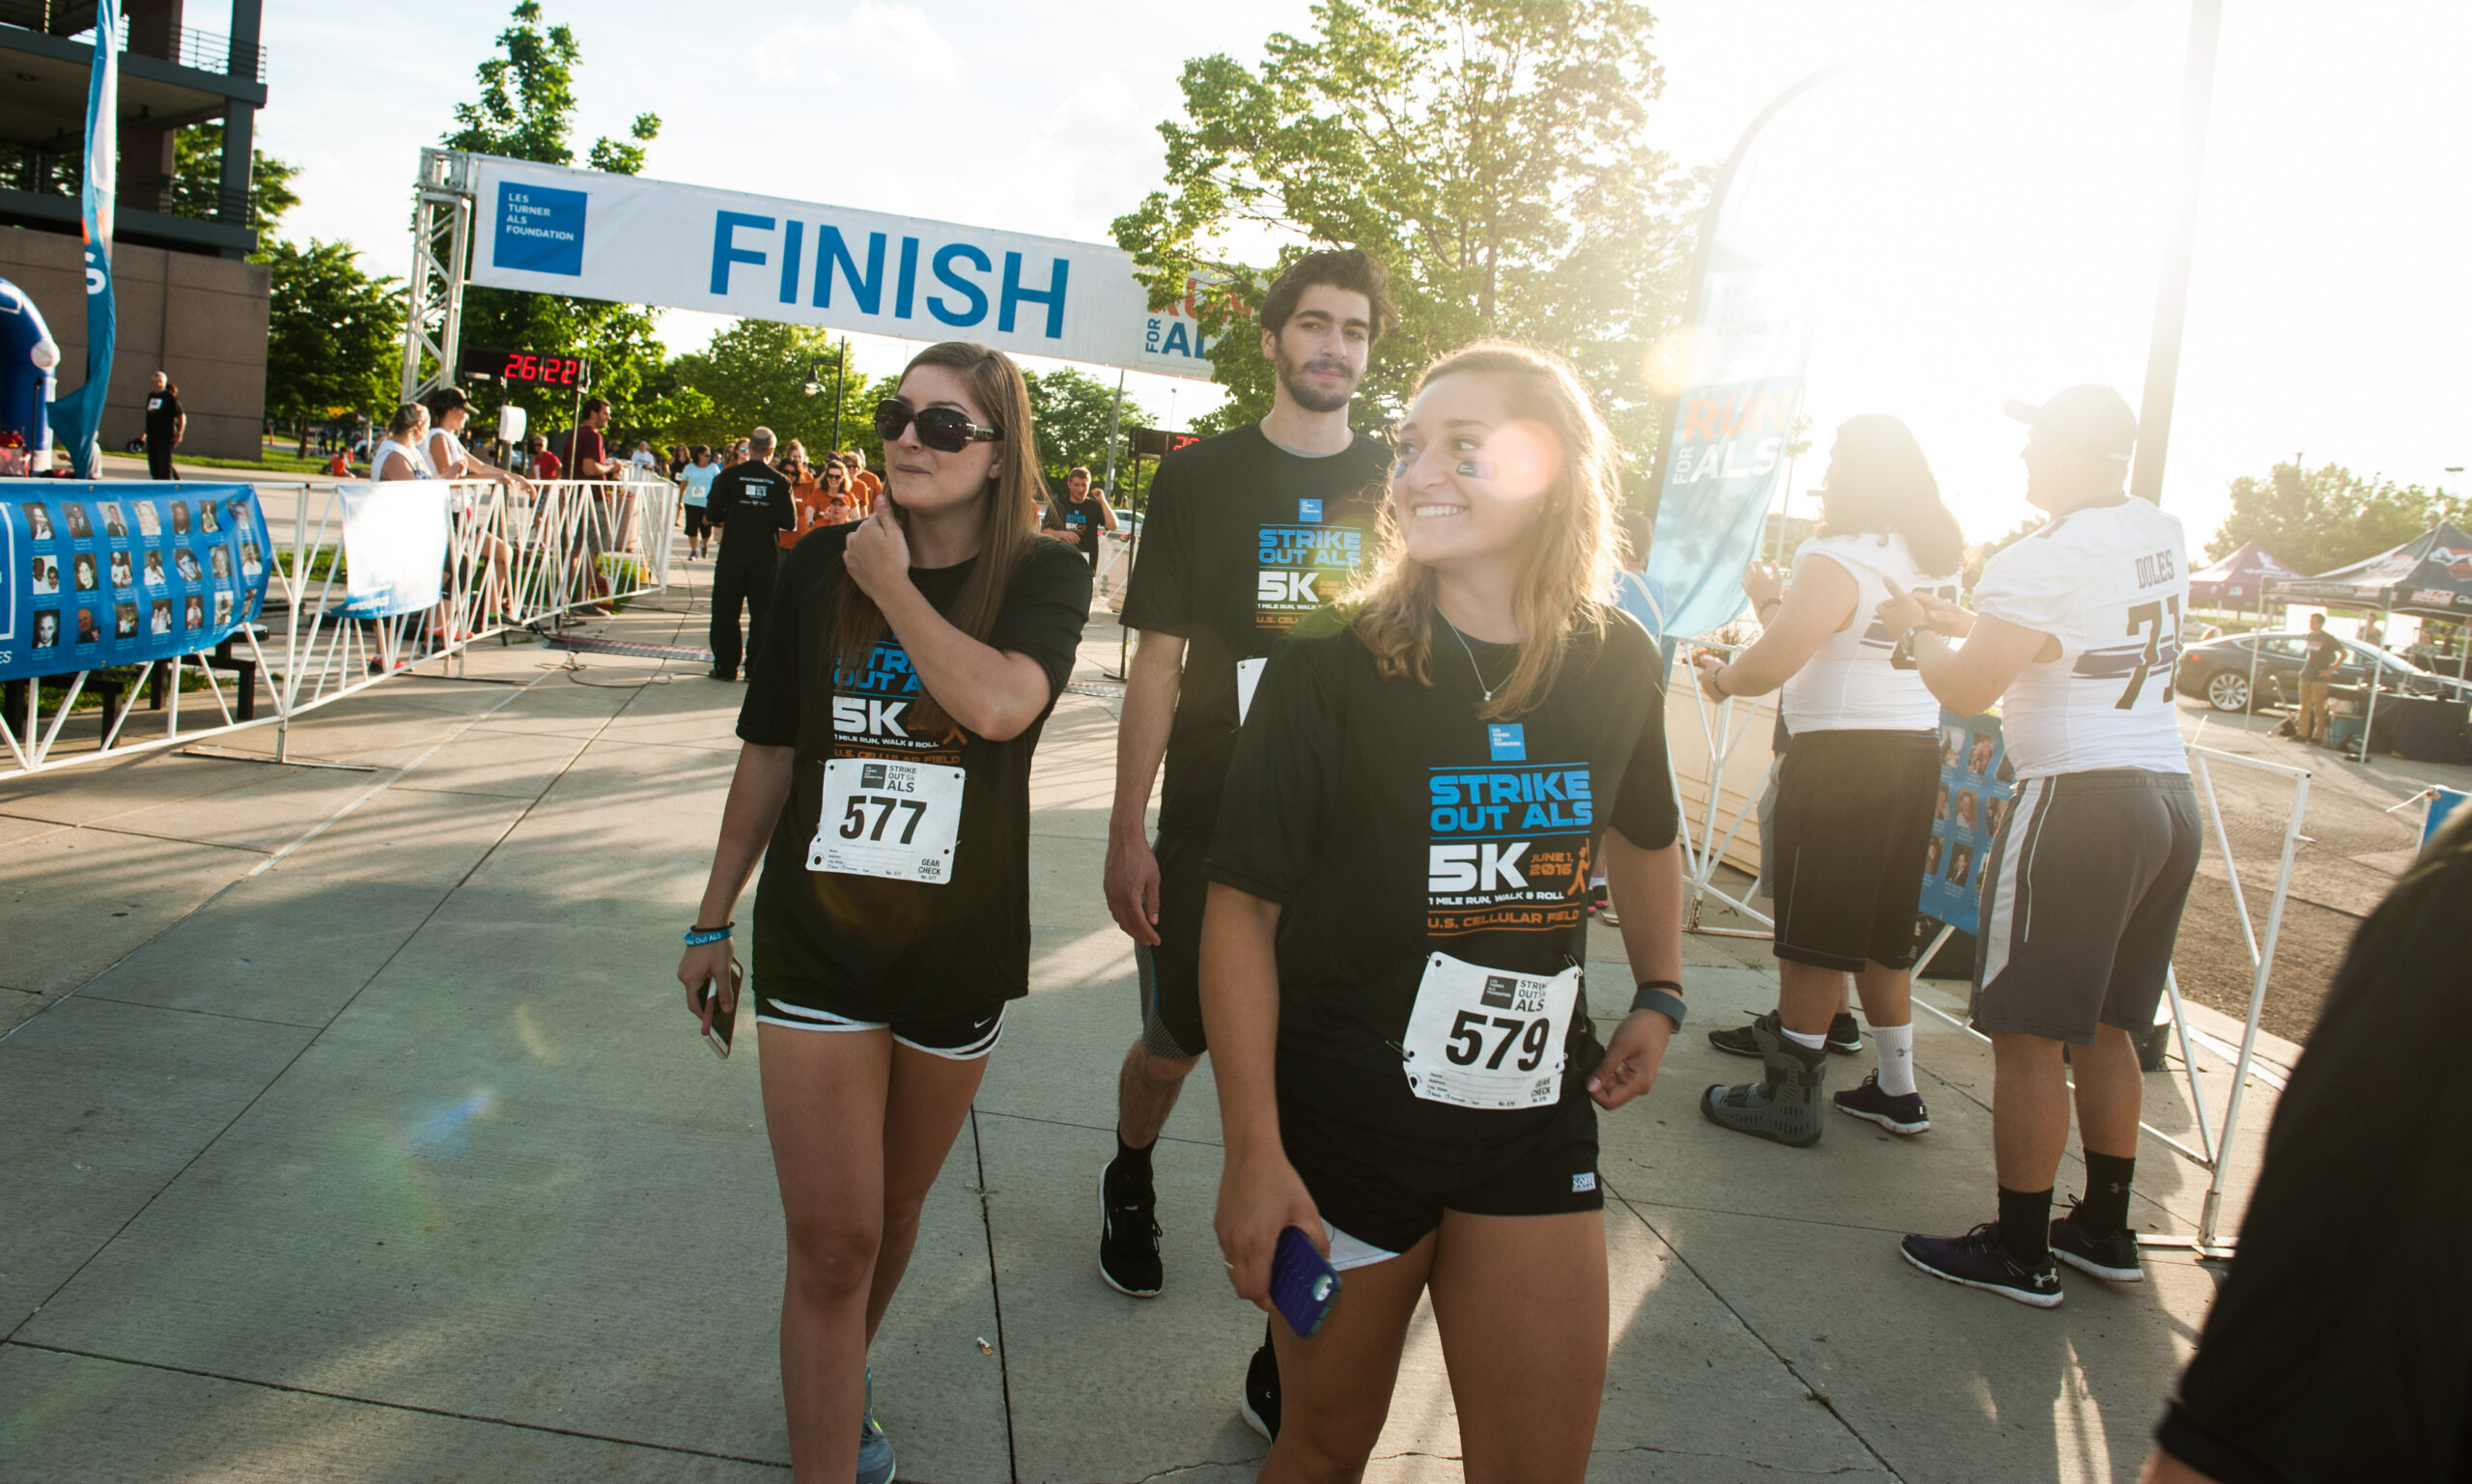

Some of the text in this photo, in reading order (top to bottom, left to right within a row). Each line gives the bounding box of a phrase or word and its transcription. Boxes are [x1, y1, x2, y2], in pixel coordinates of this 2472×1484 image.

[508, 192, 529, 203] LES
[506, 214, 527, 224] ALS
[508, 203, 551, 217] TURNER
[506, 225, 575, 241] FOUNDATION
[710, 210, 1070, 340] FINISH
[1145, 318, 1161, 353] FOR
[504, 353, 577, 384] 26:22
[1682, 389, 1795, 443] RUN
[1672, 436, 1782, 485] FOR ALS
[1258, 528, 1362, 550] STRIKE
[1258, 548, 1362, 567] OUT ALS
[2135, 548, 2175, 590] DOLES
[1257, 571, 1320, 602] 5K
[2114, 593, 2184, 710] 71
[833, 668, 895, 690] OUT
[832, 695, 910, 738] 5K
[859, 737, 880, 745] RUN,
[882, 739, 907, 747] WALK
[834, 748, 855, 758] U.S.
[924, 756, 961, 765] FIELD
[889, 765, 918, 774] STRIKE
[886, 780, 914, 793] ALS
[1429, 770, 1592, 805] STRIKE
[839, 795, 928, 845] 577
[1430, 800, 1593, 832] OUT ALS
[921, 858, 941, 867] GEAR
[1428, 842, 1531, 893] 5K
[1531, 853, 1565, 863] JUNE
[917, 866, 941, 876] CHECK
[1529, 862, 1572, 876] 2016
[1436, 896, 1463, 906] MILE
[1465, 895, 1492, 905] RUN,
[1495, 891, 1524, 903] WALK
[1536, 891, 1565, 901] ROLL
[1427, 909, 1580, 929] U.S. CELLULAR FIELD
[1518, 988, 1538, 999] OUT
[1515, 998, 1545, 1012] ALS
[1446, 1009, 1550, 1072] 579
